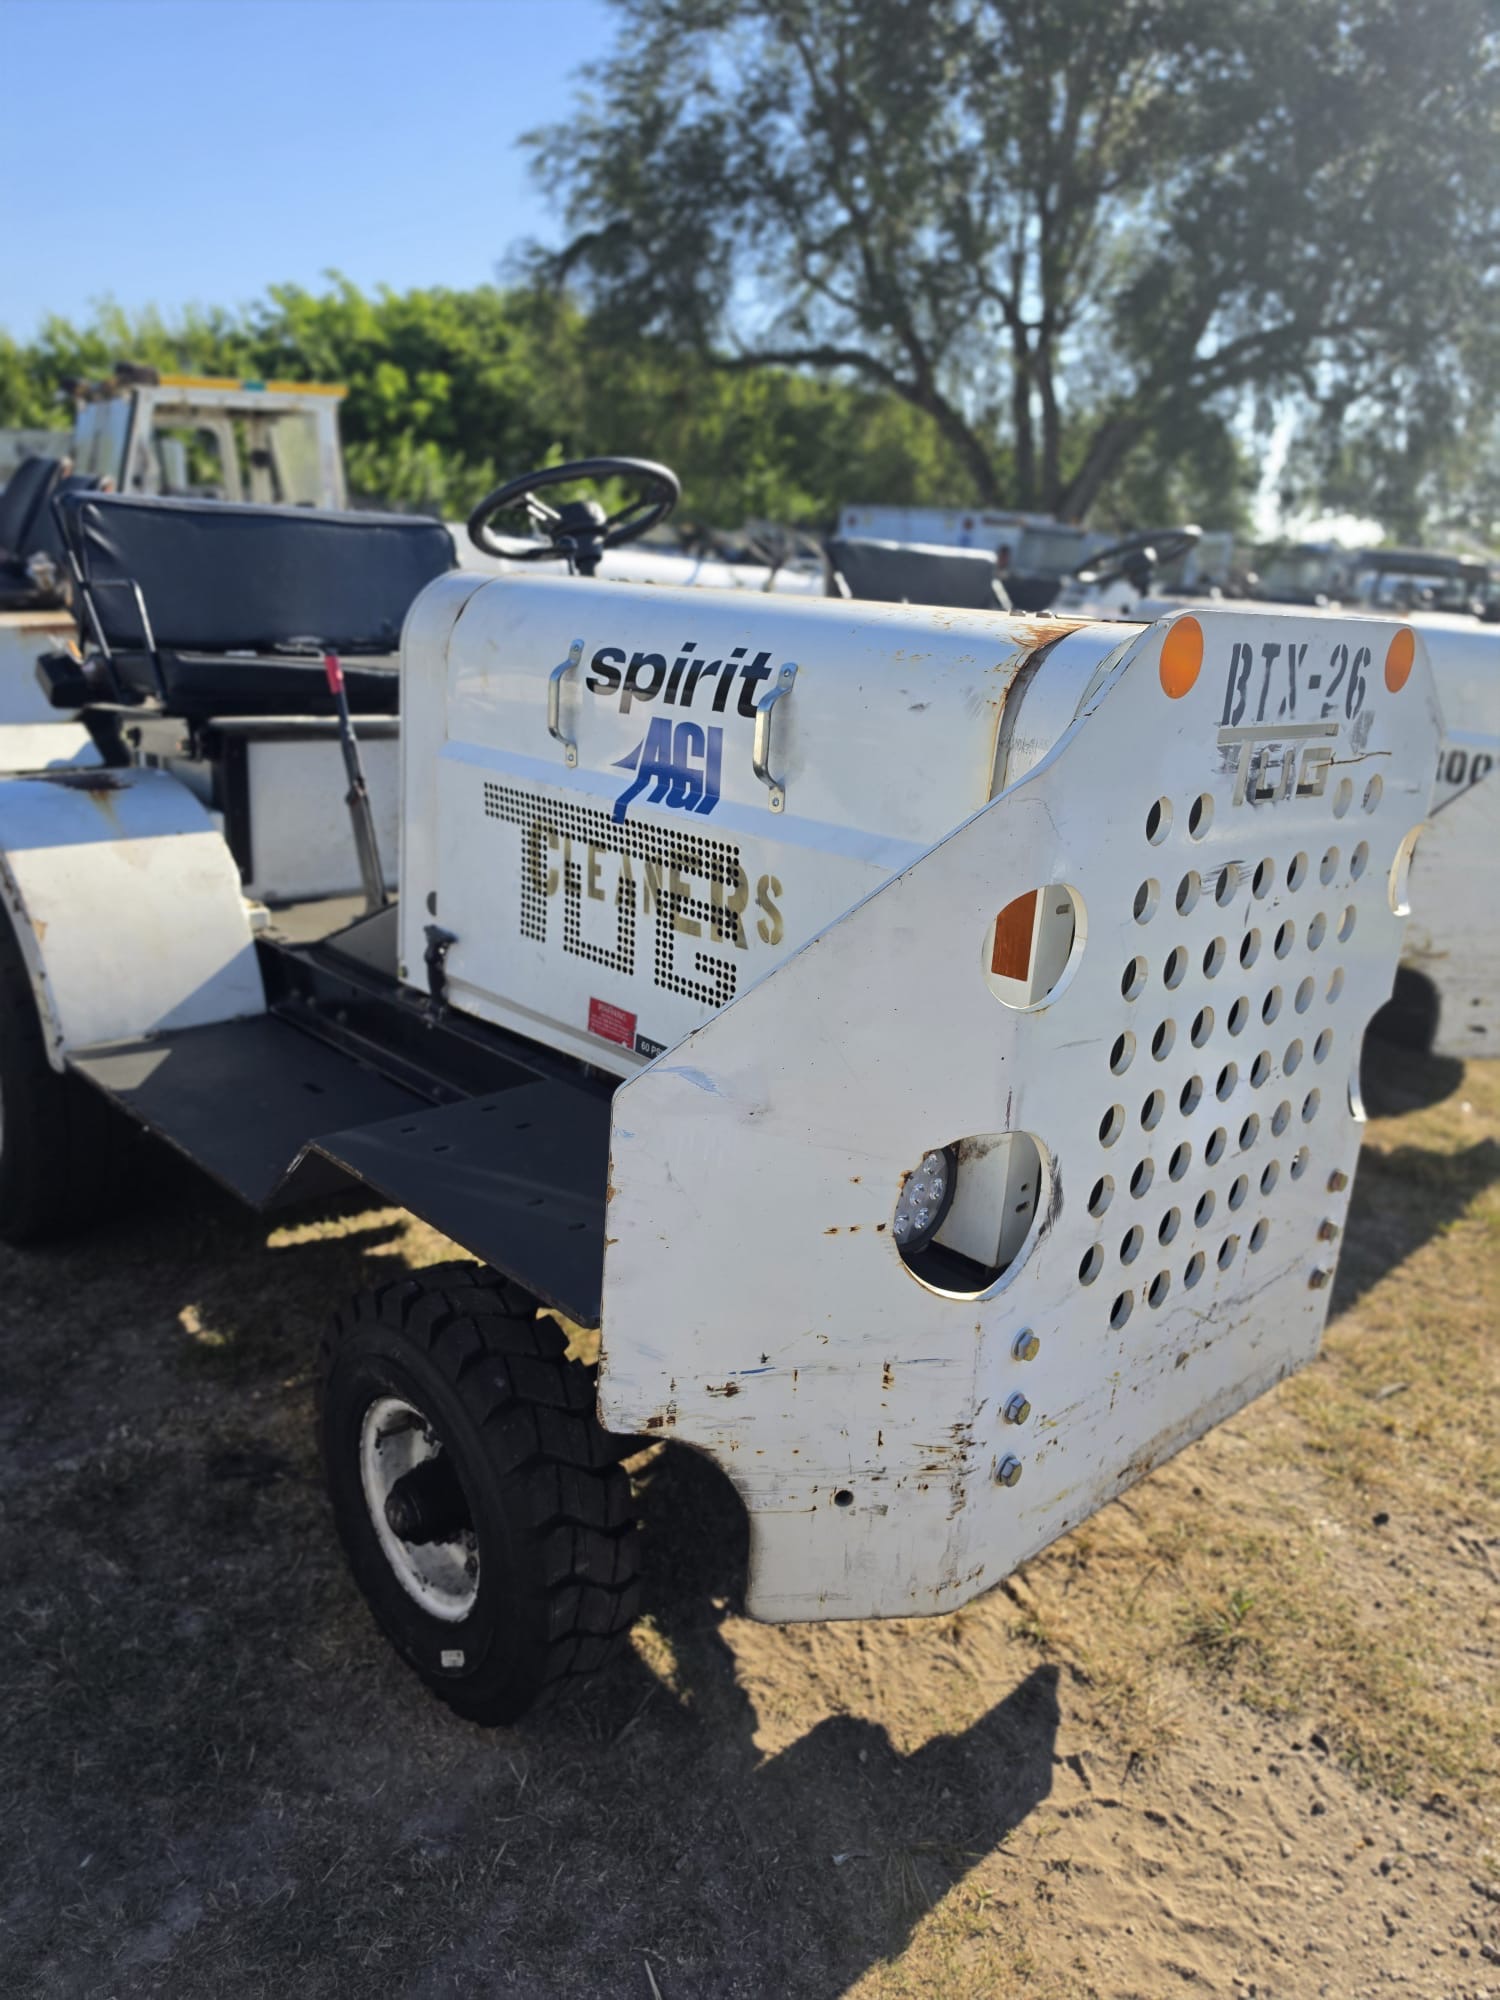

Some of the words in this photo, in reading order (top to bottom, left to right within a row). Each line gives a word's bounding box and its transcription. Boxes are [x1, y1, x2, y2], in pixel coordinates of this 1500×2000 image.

[586, 642, 772, 718] spirit
[1222, 643, 1371, 727] BTX-26
[610, 717, 723, 824] AGI
[527, 818, 784, 949] CLEANERS
[641, 1041, 650, 1053] 60
[651, 1045, 663, 1057] PS
